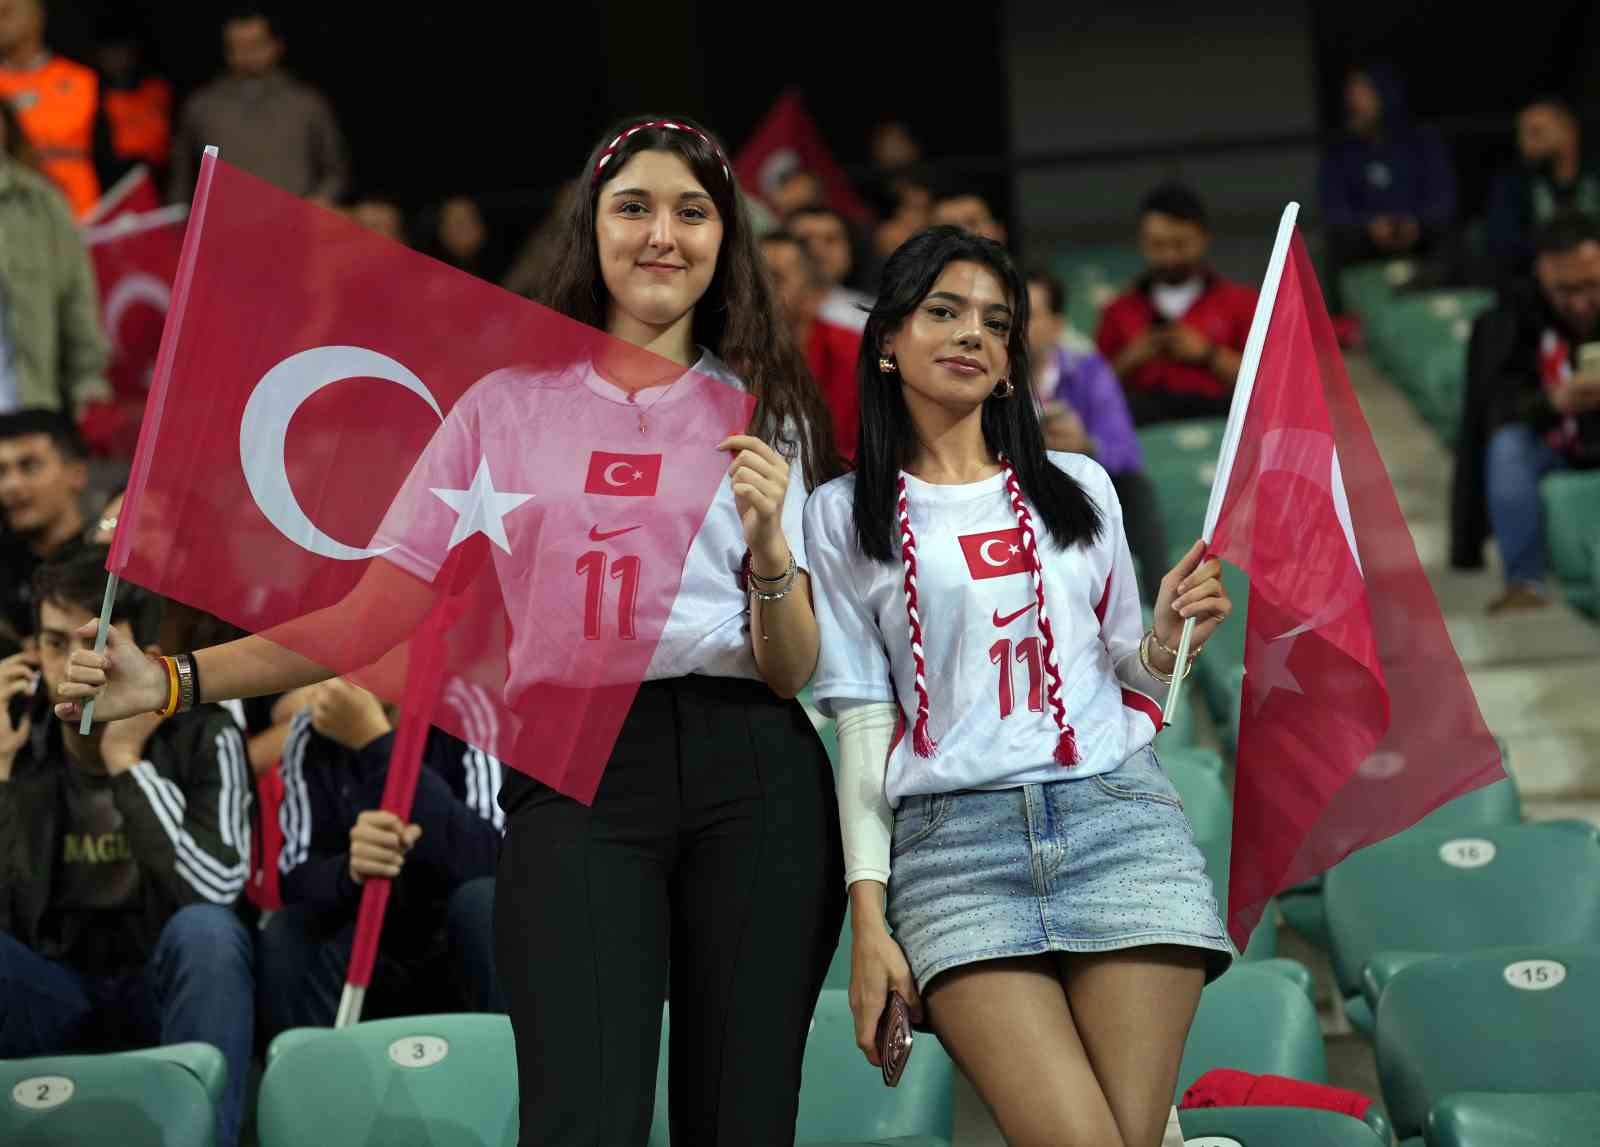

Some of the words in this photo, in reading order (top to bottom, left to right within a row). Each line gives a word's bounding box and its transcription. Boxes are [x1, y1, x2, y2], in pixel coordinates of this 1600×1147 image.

[576, 550, 640, 640] 11
[989, 637, 1044, 720] 11
[1521, 966, 1549, 983] 15
[411, 1042, 425, 1060] 3
[36, 1083, 49, 1101] 2
